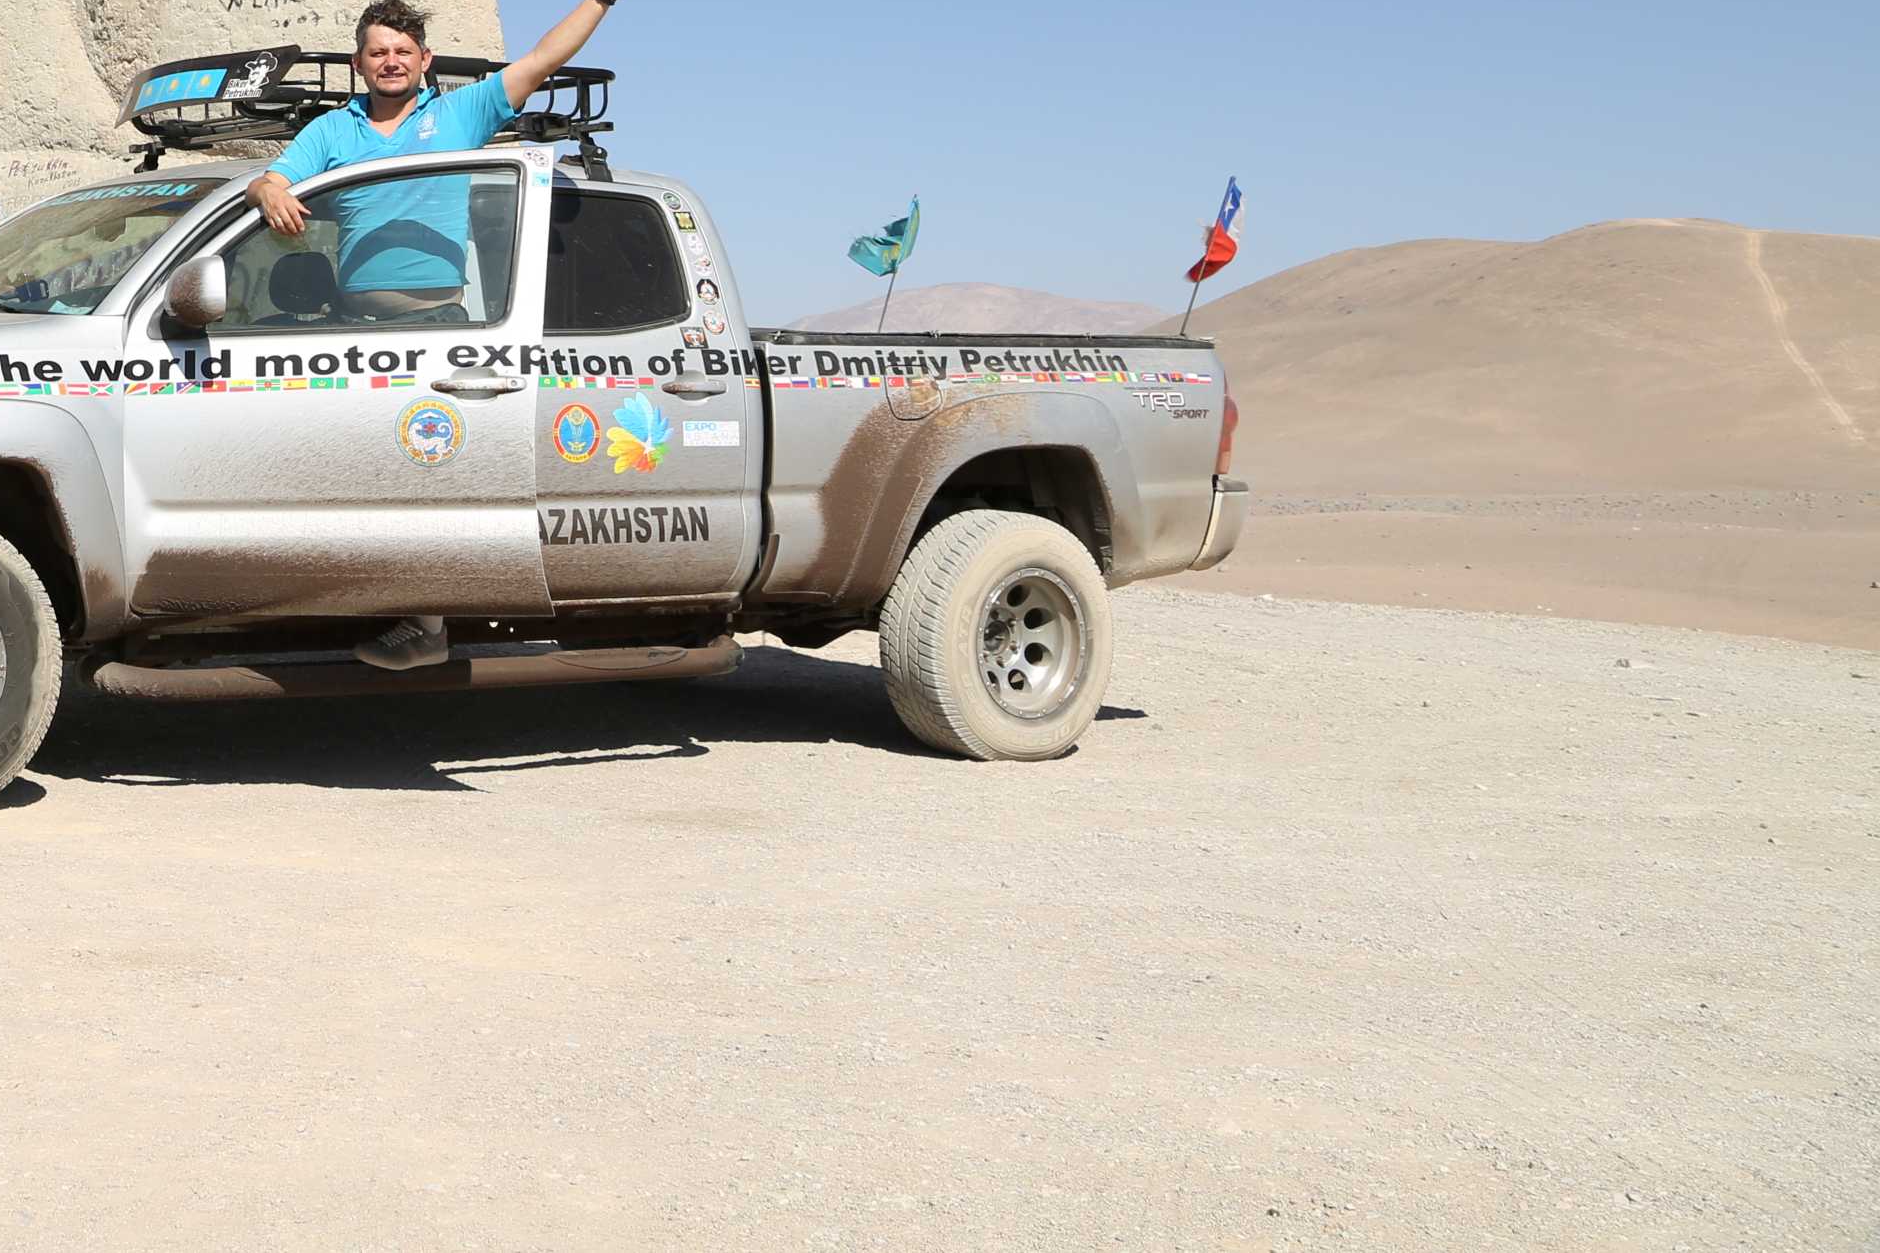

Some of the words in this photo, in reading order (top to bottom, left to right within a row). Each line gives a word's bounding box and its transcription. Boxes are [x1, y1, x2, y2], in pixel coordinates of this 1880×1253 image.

[228, 79, 249, 89] Biker
[223, 88, 263, 98] Petrukhin
[80, 349, 232, 382] world
[255, 345, 426, 378] motor
[647, 349, 686, 376] of
[700, 348, 802, 377] Biker
[813, 350, 948, 380] Dmitriy
[958, 348, 1129, 375] Petrukhin
[1132, 391, 1186, 413] TRD
[1172, 408, 1210, 420] SPORT
